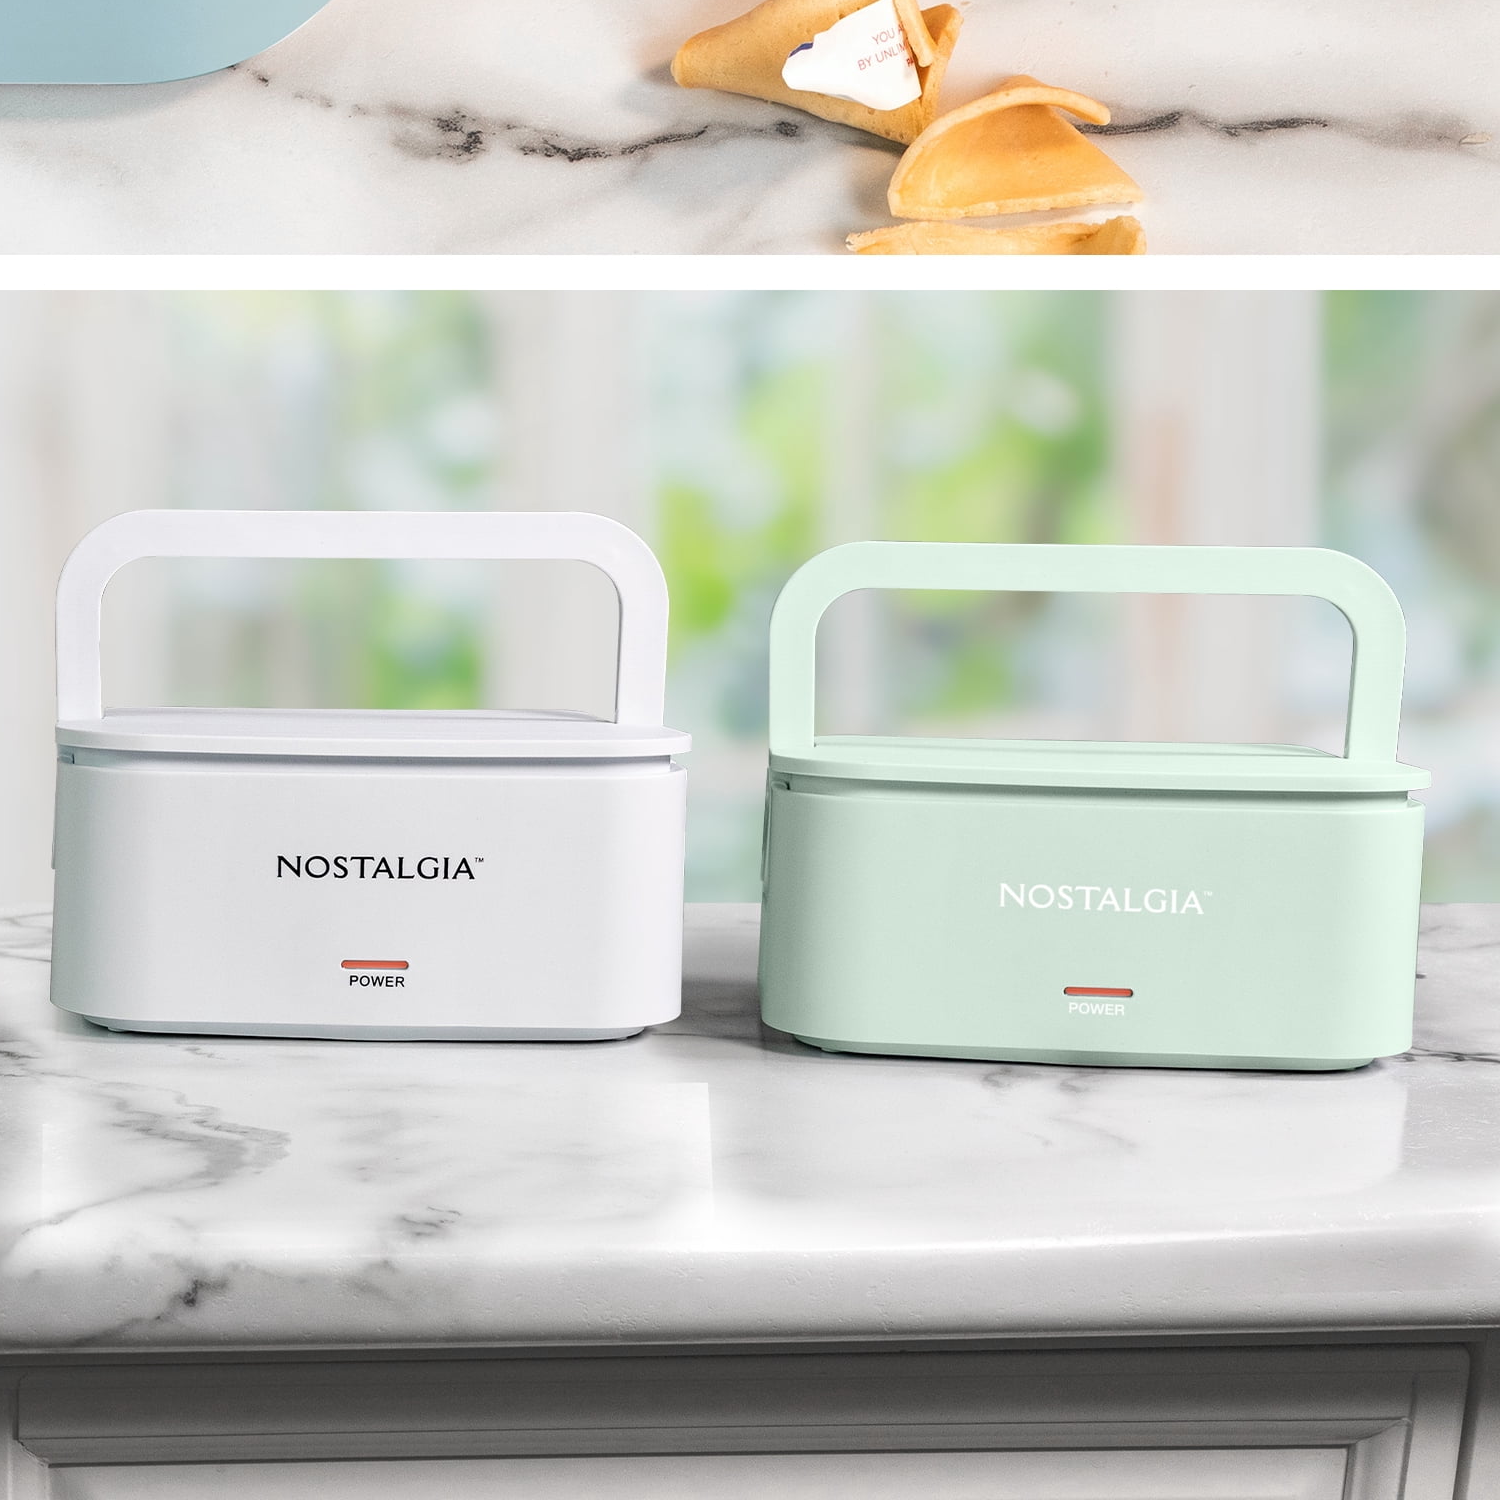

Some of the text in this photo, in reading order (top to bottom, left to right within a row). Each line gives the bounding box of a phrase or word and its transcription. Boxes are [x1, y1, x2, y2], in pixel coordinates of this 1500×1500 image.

[871, 27, 896, 45] YOU
[857, 55, 872, 71] BY
[348, 975, 405, 988] POWER
[1068, 1002, 1125, 1016] POWER
